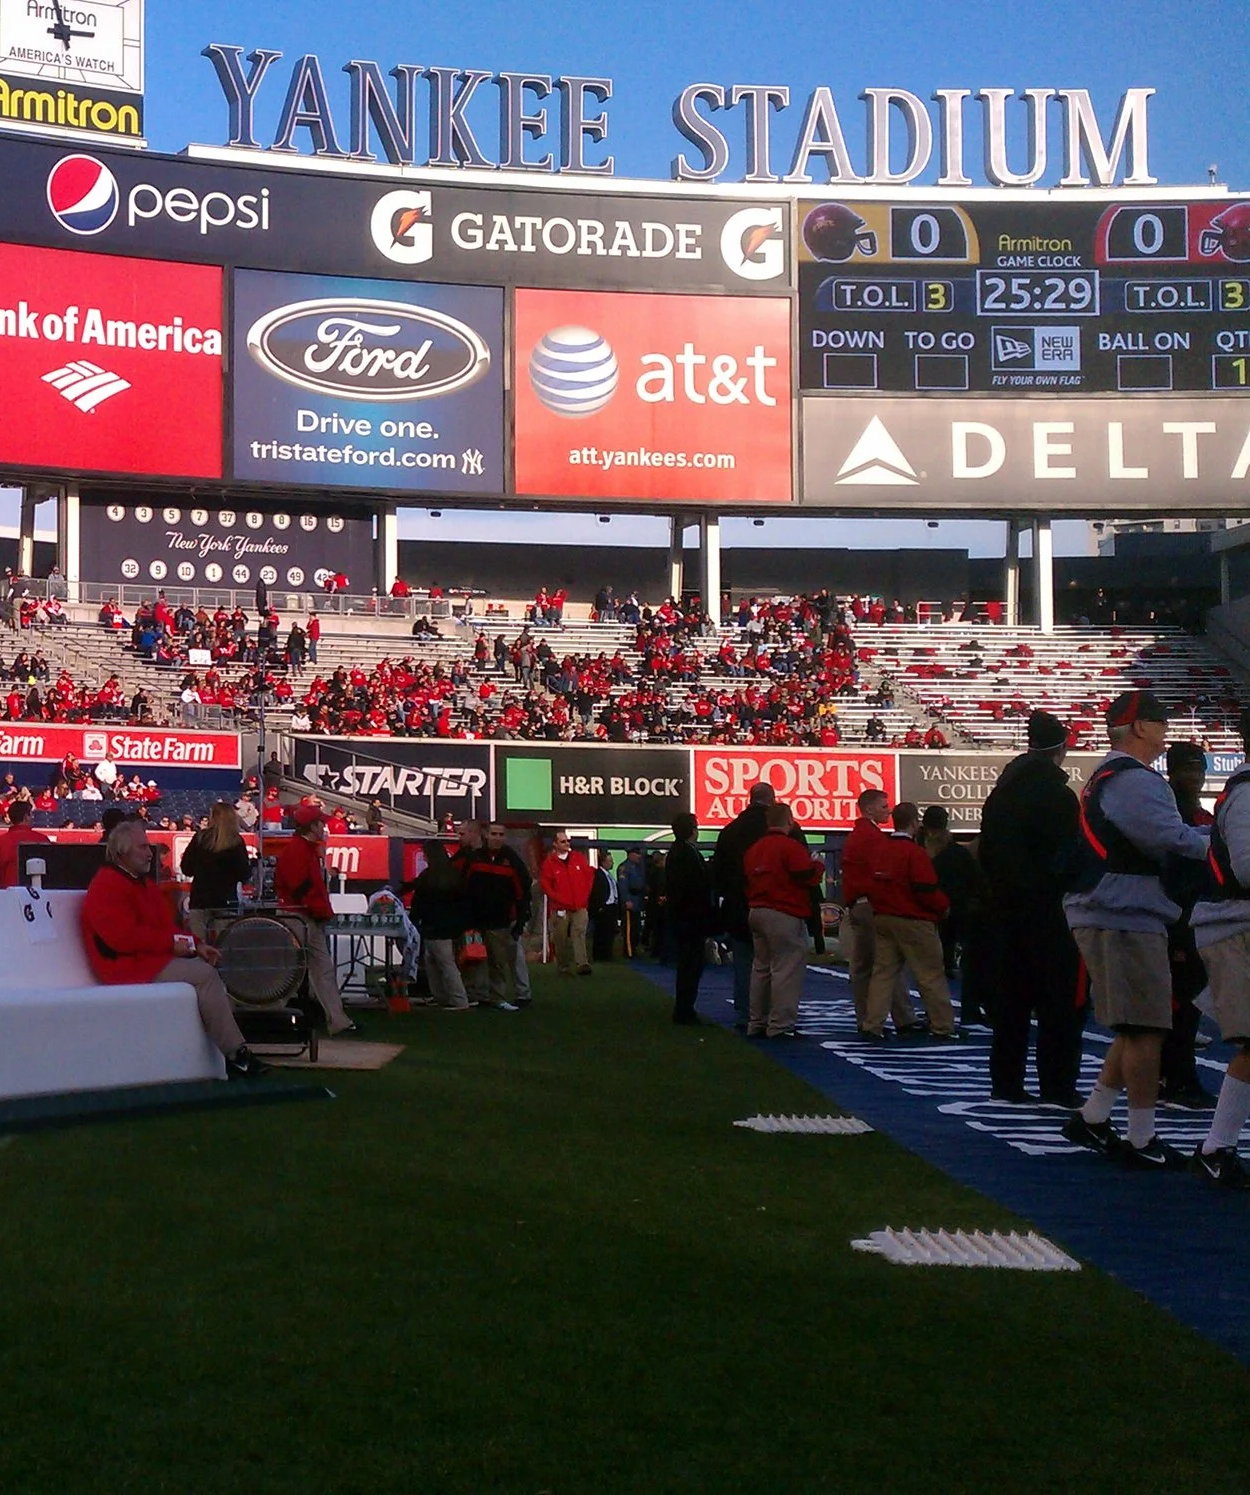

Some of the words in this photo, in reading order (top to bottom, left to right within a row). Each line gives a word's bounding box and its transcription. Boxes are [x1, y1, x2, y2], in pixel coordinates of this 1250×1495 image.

[27, 0, 97, 27] Armitron
[8, 47, 72, 66] AMERICA'S
[76, 56, 115, 72] WATCH
[201, 43, 614, 176] YANKEE
[671, 82, 1158, 188] STADIUM
[128, 187, 270, 235] pepsi
[370, 189, 433, 265] G
[450, 211, 702, 260] GATORADE
[720, 207, 784, 281] G
[911, 213, 941, 254] 0
[998, 233, 1072, 252] Armitron
[1133, 213, 1164, 254] 0
[997, 255, 1034, 268] GAME
[1037, 256, 1081, 268] CLOCK
[840, 284, 909, 307] T.O.L.
[927, 283, 946, 310] 3
[984, 277, 1092, 310] 25:29
[1134, 286, 1206, 308] T.O.L.
[1224, 282, 1245, 309] 3
[42, 305, 79, 342] of
[81, 307, 222, 356] America
[811, 330, 885, 349] DOWN
[904, 331, 936, 349] TO
[941, 332, 976, 350] GO
[1041, 336, 1074, 348] NEW
[1098, 332, 1149, 351] BALL
[1154, 332, 1191, 350] ON
[1216, 330, 1250, 352] QT
[304, 317, 434, 380] Ford
[1041, 349, 1074, 361] ERA
[636, 342, 777, 407] at&t
[991, 375, 1008, 386] FLY
[1009, 375, 1034, 386] YOUR
[1035, 375, 1058, 386] OWN
[1059, 375, 1082, 386] FLAG
[1231, 358, 1246, 385] 1
[296, 408, 372, 437] Drive
[379, 418, 439, 440] one.
[250, 439, 456, 470] tristateford.com
[568, 446, 736, 471] att.yankees.com
[221, 512, 233, 523] 37
[304, 516, 314, 526] 16
[330, 517, 340, 528] 15
[165, 531, 199, 549] New
[198, 533, 234, 558] York
[234, 535, 289, 560] Yankees
[124, 563, 137, 574] 32
[181, 566, 191, 576] 10
[234, 569, 247, 579] 44
[262, 570, 275, 580] 23
[289, 571, 301, 581] 49
[338, 765, 487, 797] STARTER
[559, 776, 605, 795] H&R
[610, 776, 680, 797] BLOCK
[704, 757, 884, 797] SPORTS
[920, 765, 999, 782] YANKEES
[706, 796, 859, 821] AUORIT
